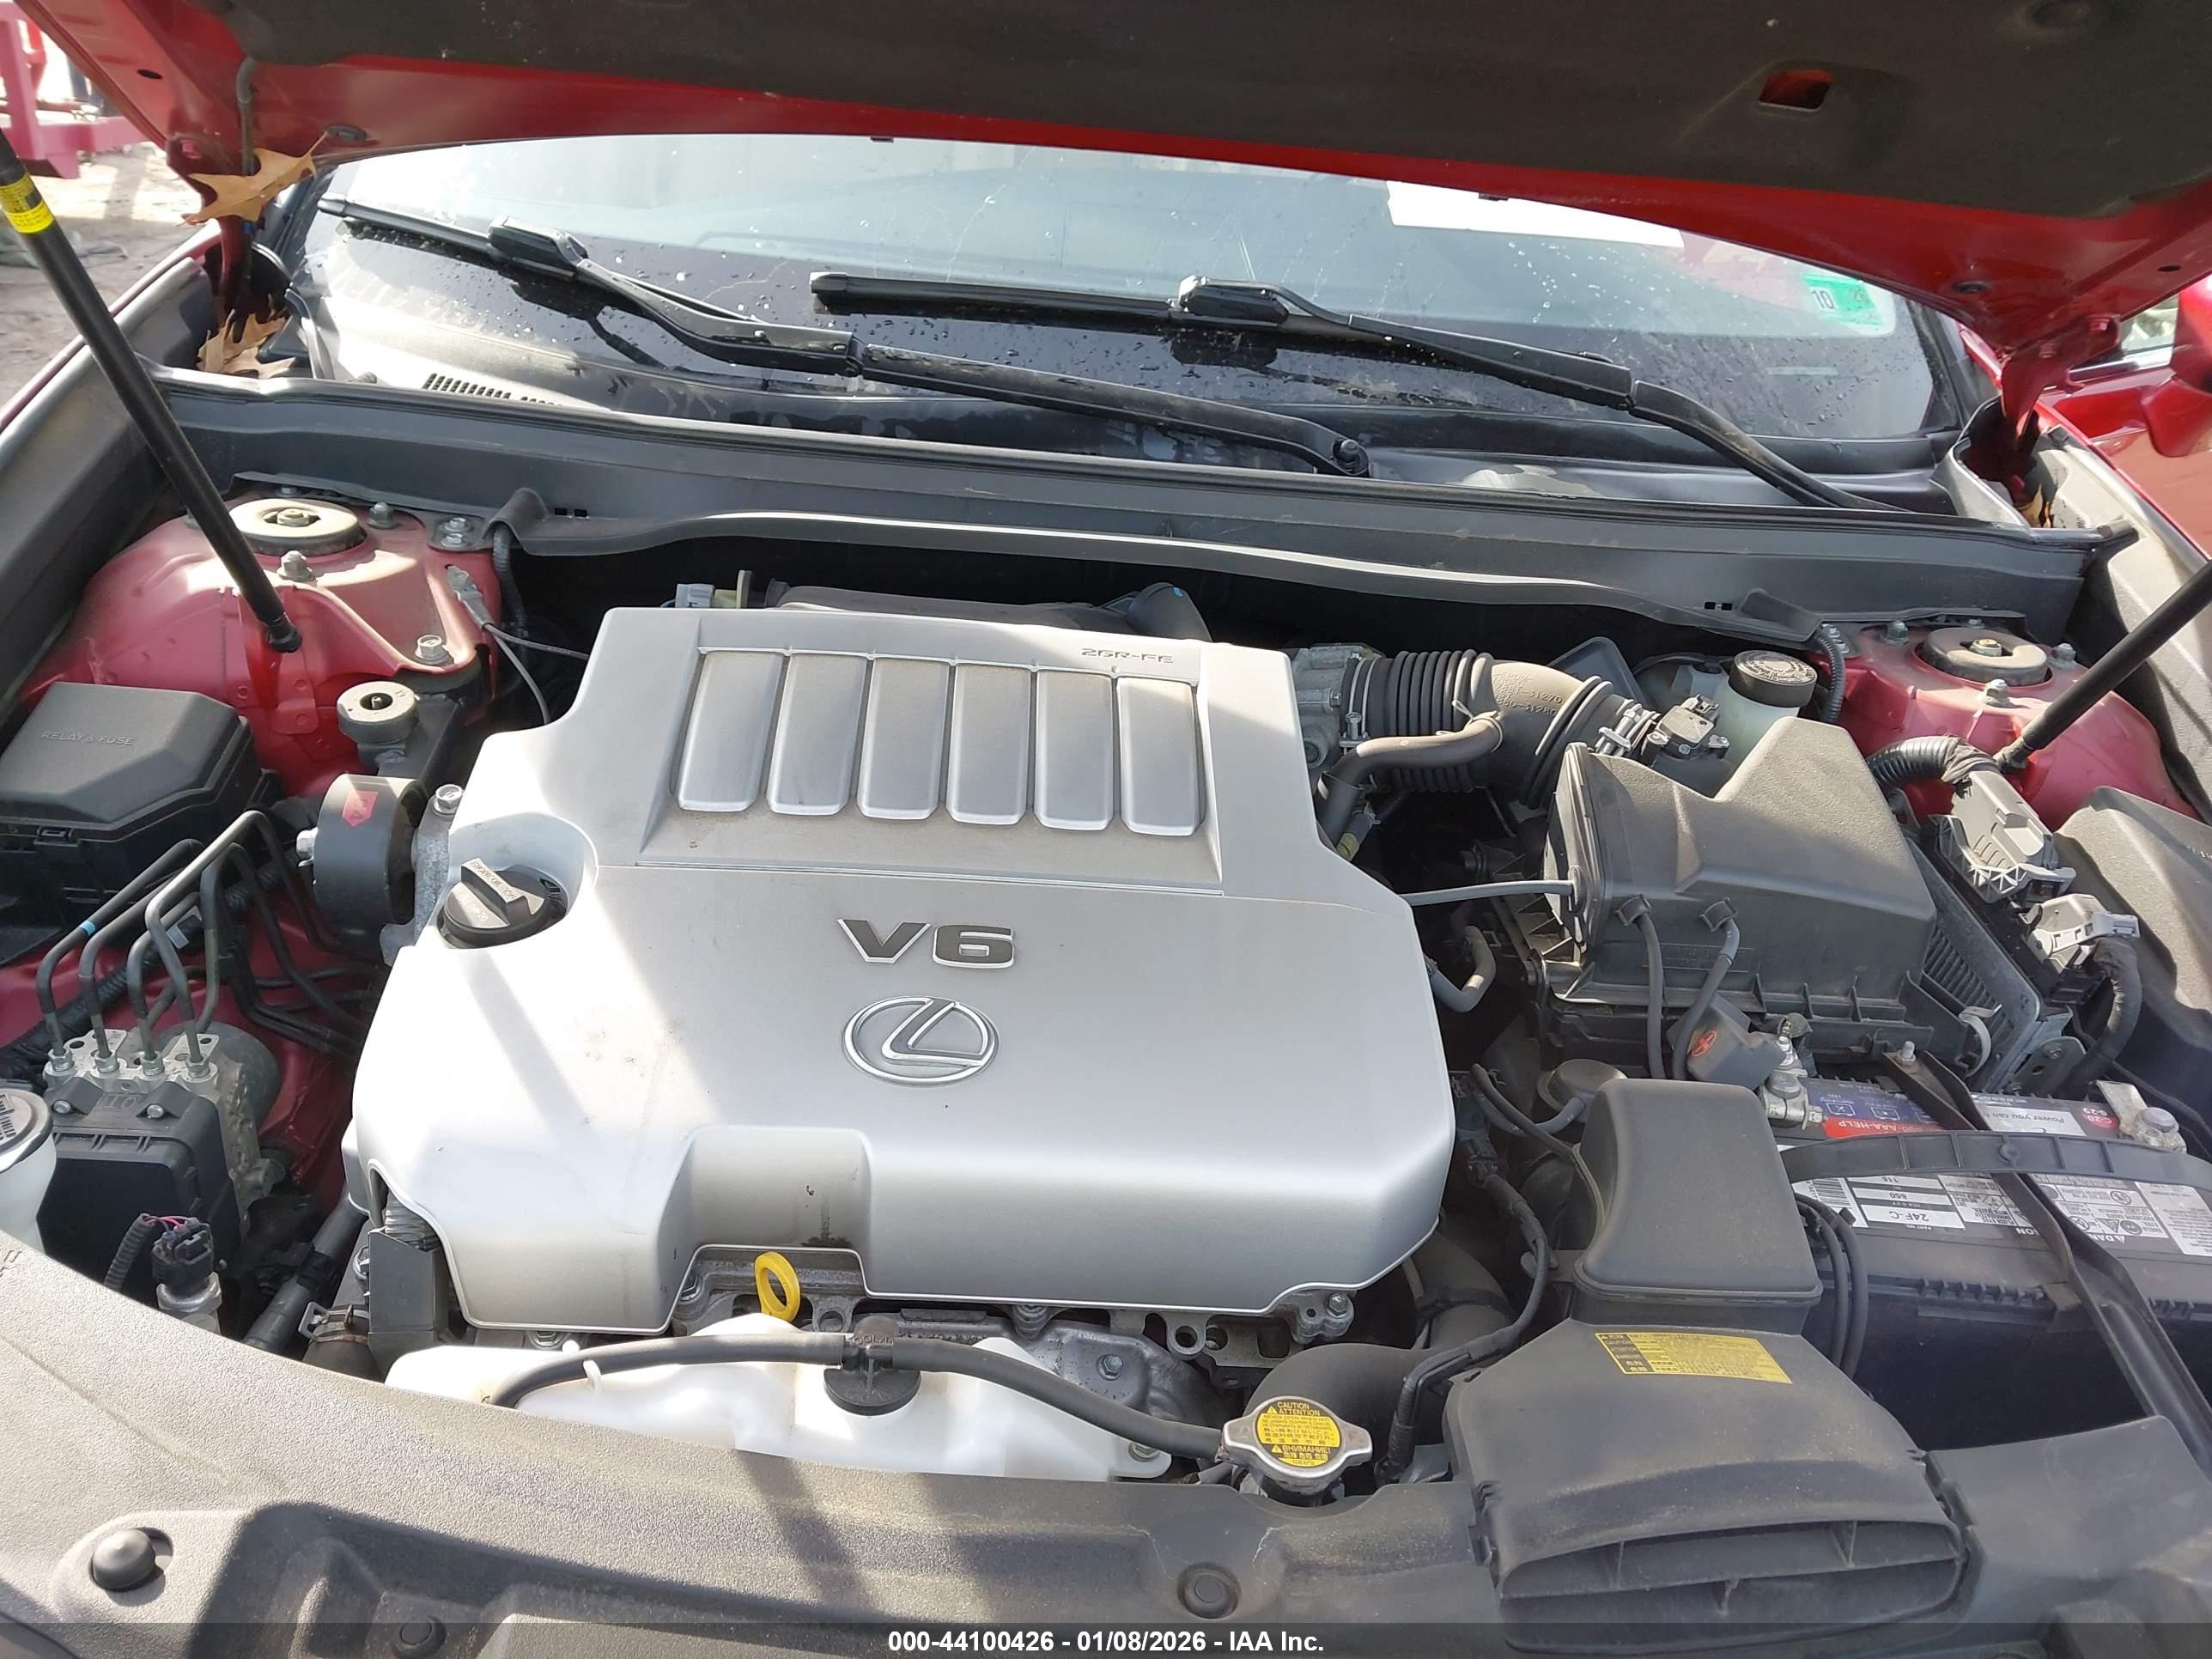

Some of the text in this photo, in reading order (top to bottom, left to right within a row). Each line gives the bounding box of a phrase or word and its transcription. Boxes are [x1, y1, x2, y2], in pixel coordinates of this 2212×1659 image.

[1812, 289, 1835, 310] 10
[1081, 647, 1174, 664] 2GR-FE
[98, 734, 136, 746] FUSE
[836, 917, 1017, 969] V6
[2012, 1113, 2030, 1121] you
[2033, 1115, 2065, 1124] Power
[1888, 1211, 1929, 1222] 24F-C
[1277, 1401, 1311, 1410] CAUTION
[1279, 1408, 1321, 1417] ATTENTION
